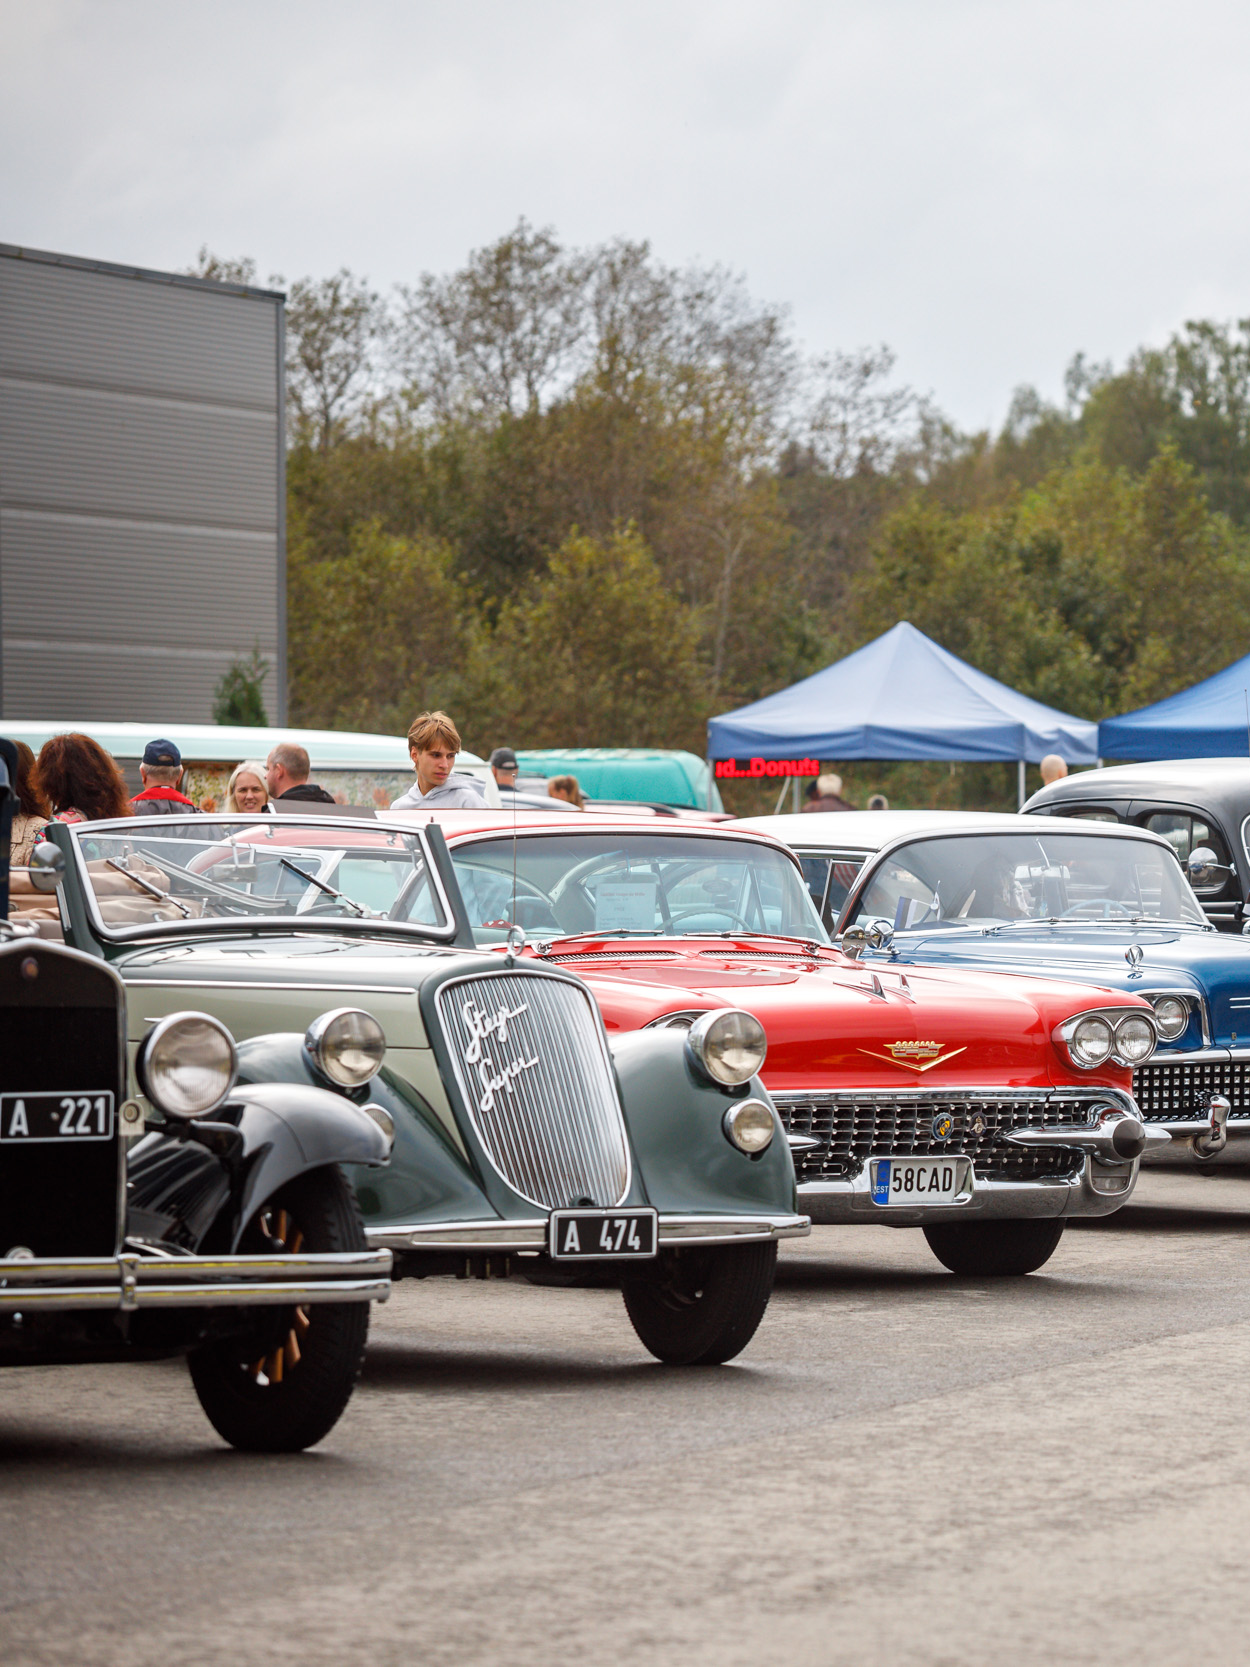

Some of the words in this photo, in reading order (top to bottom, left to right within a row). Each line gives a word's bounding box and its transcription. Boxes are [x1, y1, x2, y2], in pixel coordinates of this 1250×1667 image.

[463, 1000, 528, 1064] Steyr
[479, 1056, 539, 1112] Super
[8, 1099, 29, 1136] A
[59, 1097, 106, 1134] 221
[876, 1185, 889, 1194] EST
[892, 1167, 953, 1193] 58CAD
[563, 1220, 581, 1252] A
[599, 1219, 641, 1251] 474
